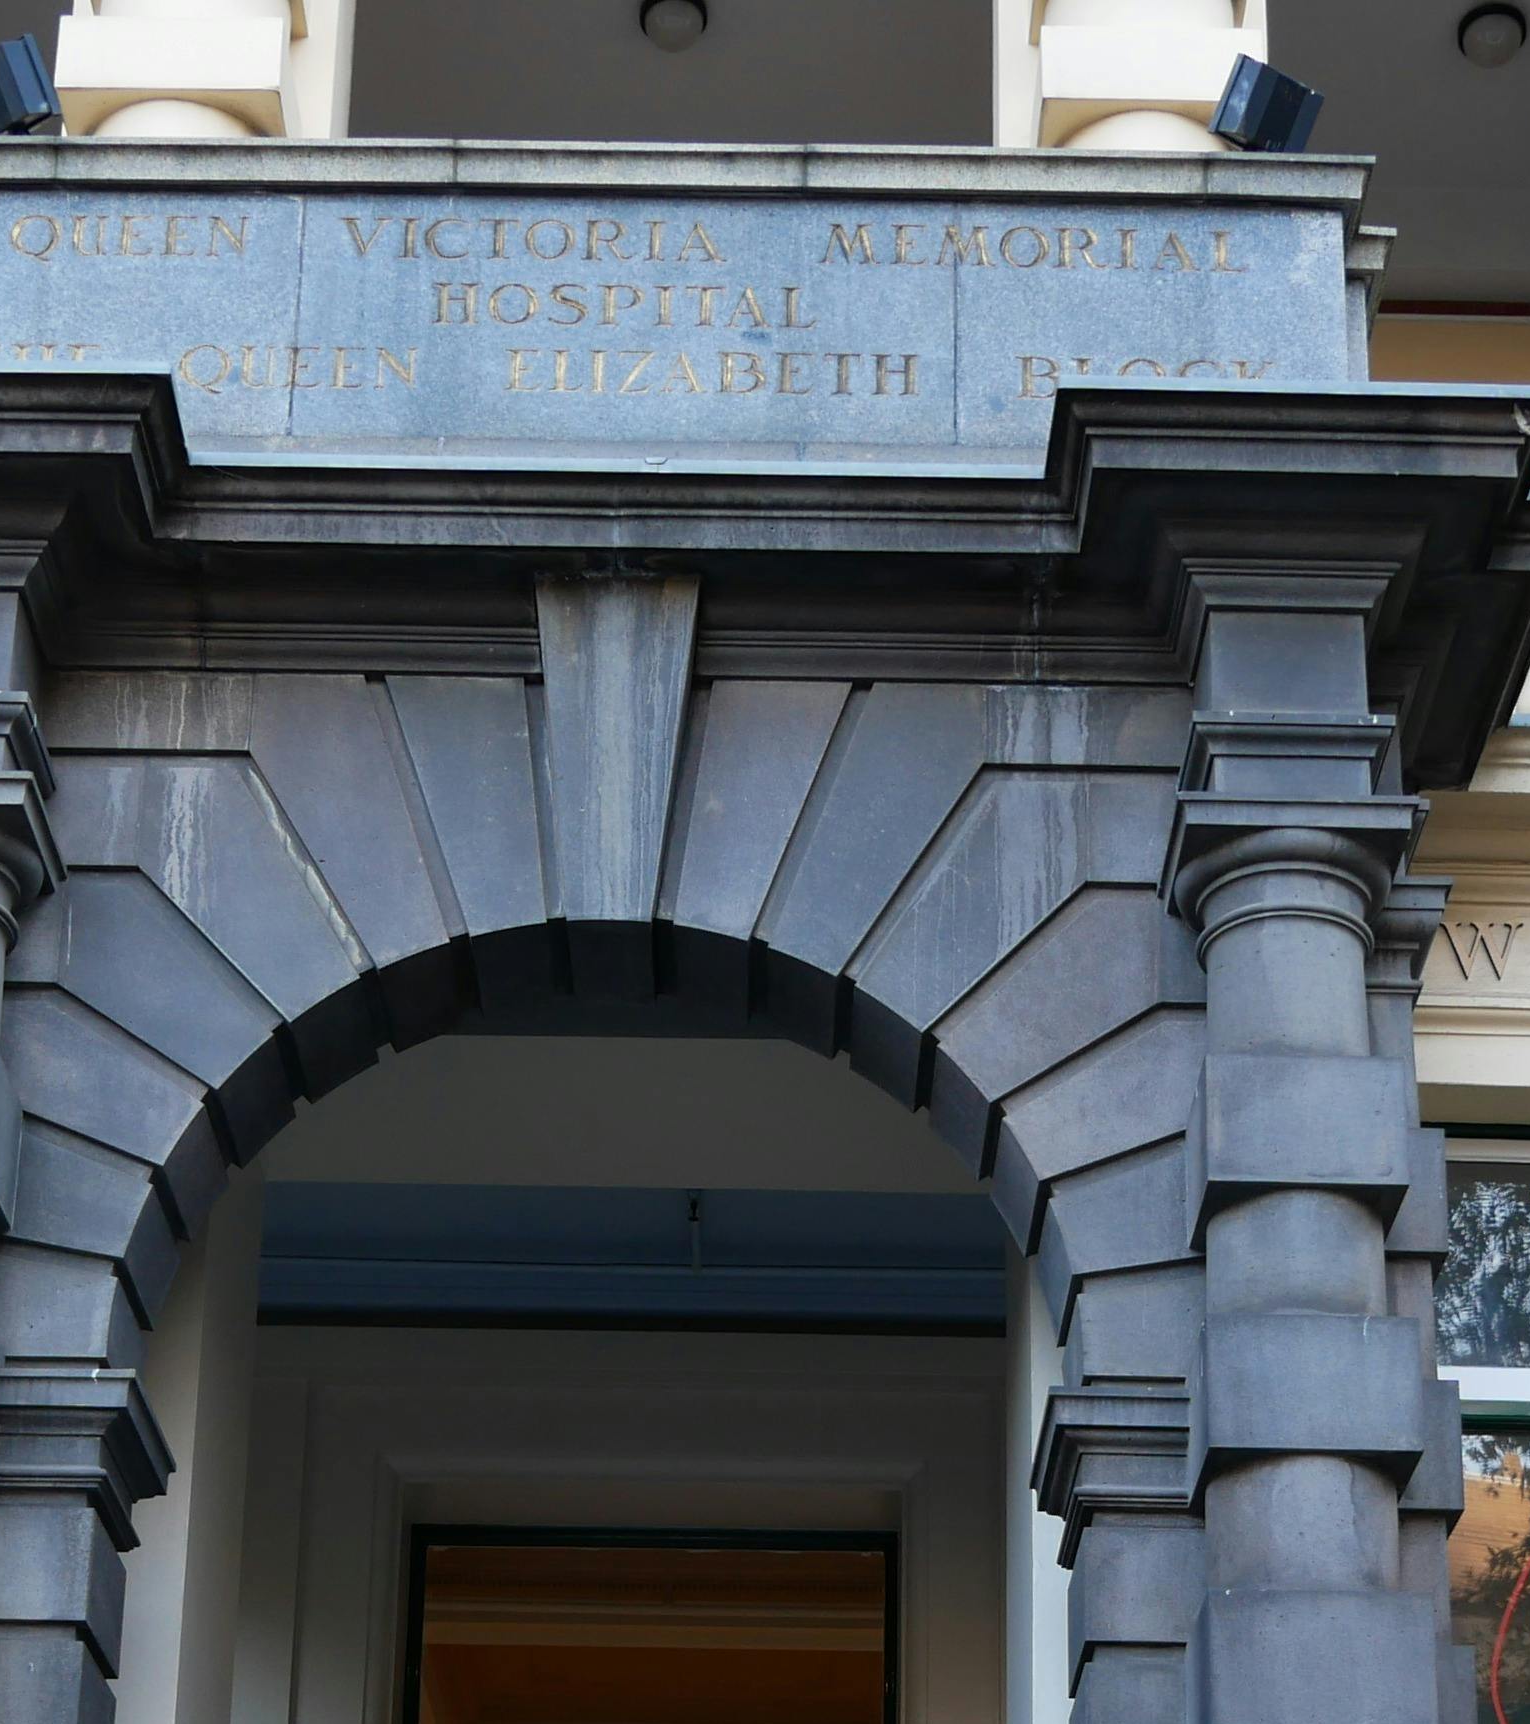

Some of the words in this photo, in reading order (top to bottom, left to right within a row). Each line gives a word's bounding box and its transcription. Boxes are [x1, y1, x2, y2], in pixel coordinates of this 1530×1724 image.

[10, 214, 249, 262] QUEEN
[340, 216, 727, 263] VICTORIA
[819, 222, 1248, 273] MEMORIAL
[432, 281, 816, 329] HOSPITAL
[179, 343, 419, 394] QUEEN
[505, 348, 919, 396] ELIZABETH
